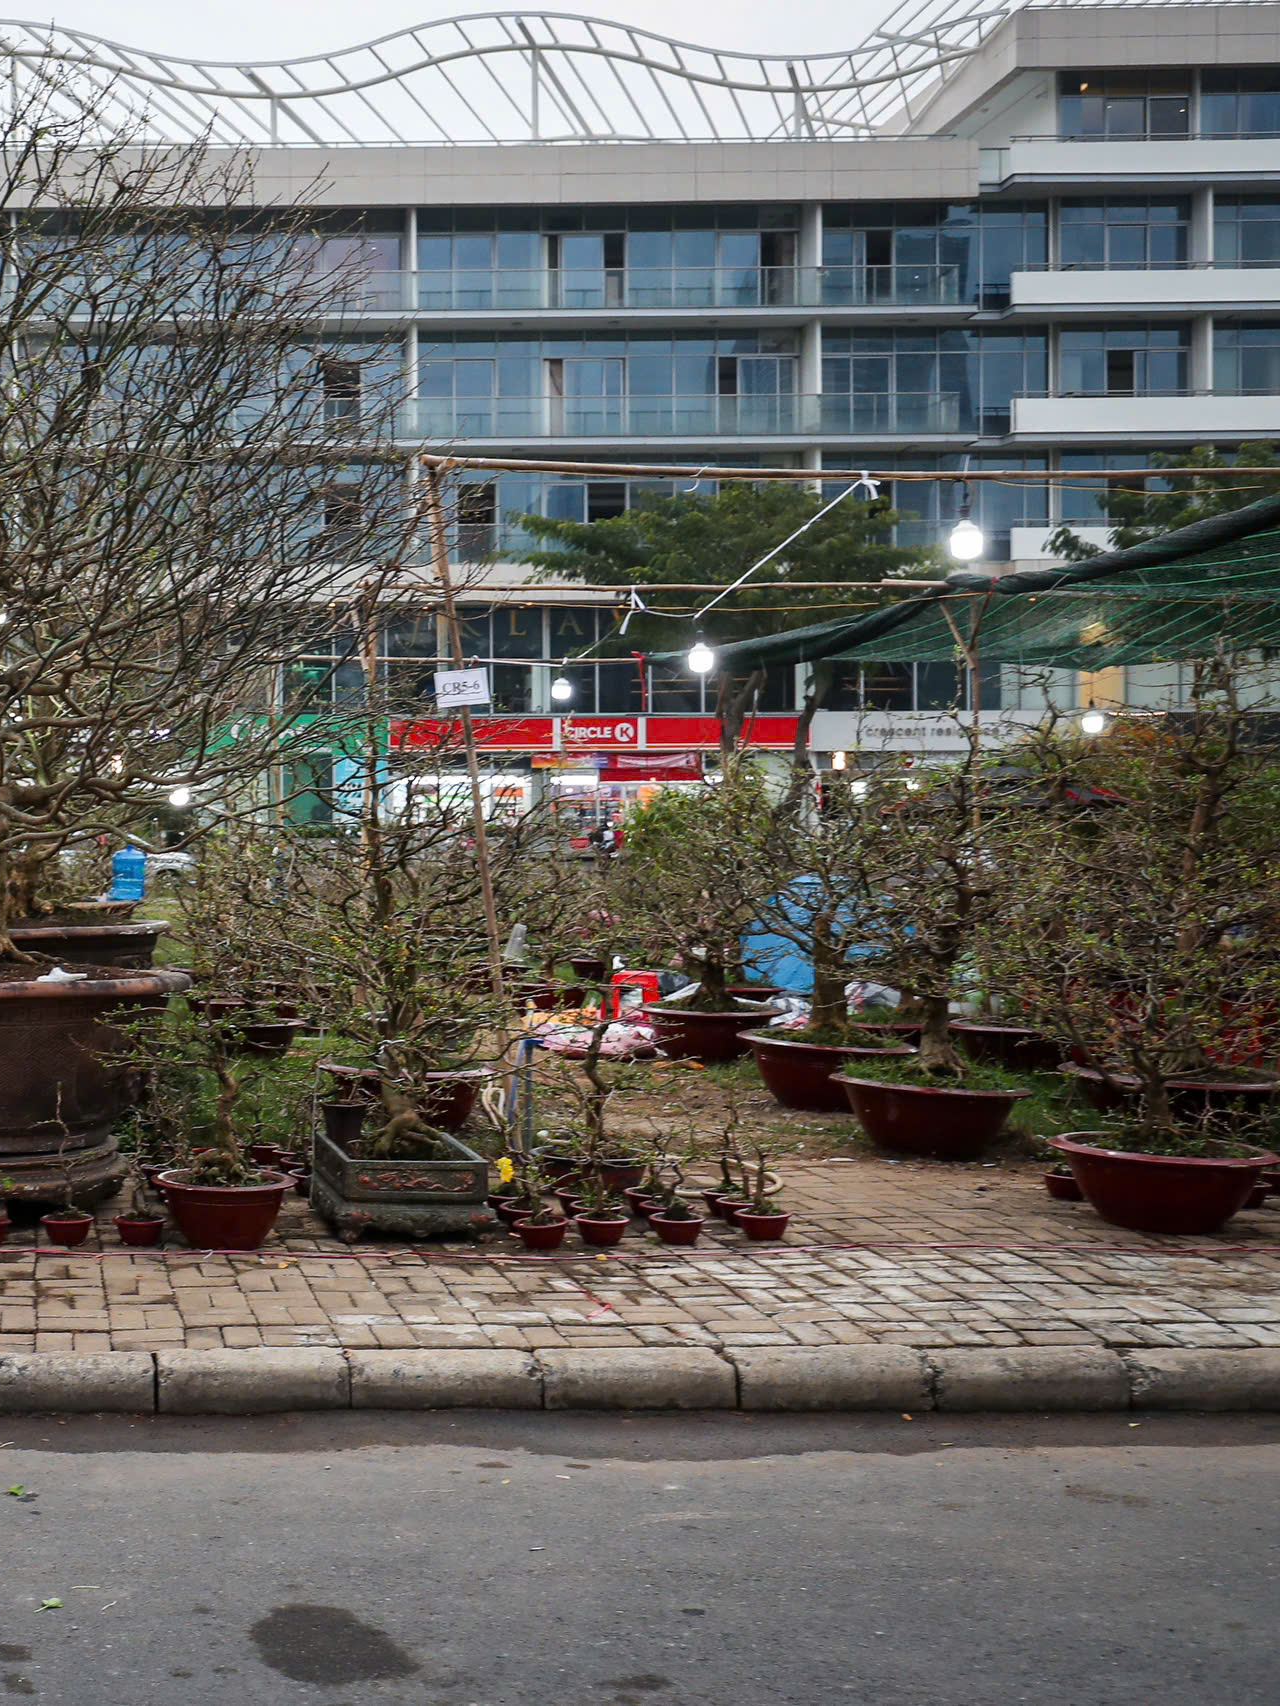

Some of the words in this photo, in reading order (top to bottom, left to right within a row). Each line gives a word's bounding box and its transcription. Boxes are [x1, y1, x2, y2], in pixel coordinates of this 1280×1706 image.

[442, 680, 480, 693] CR5-6
[567, 726, 612, 738] CIRCLE
[865, 726, 926, 737] crescent
